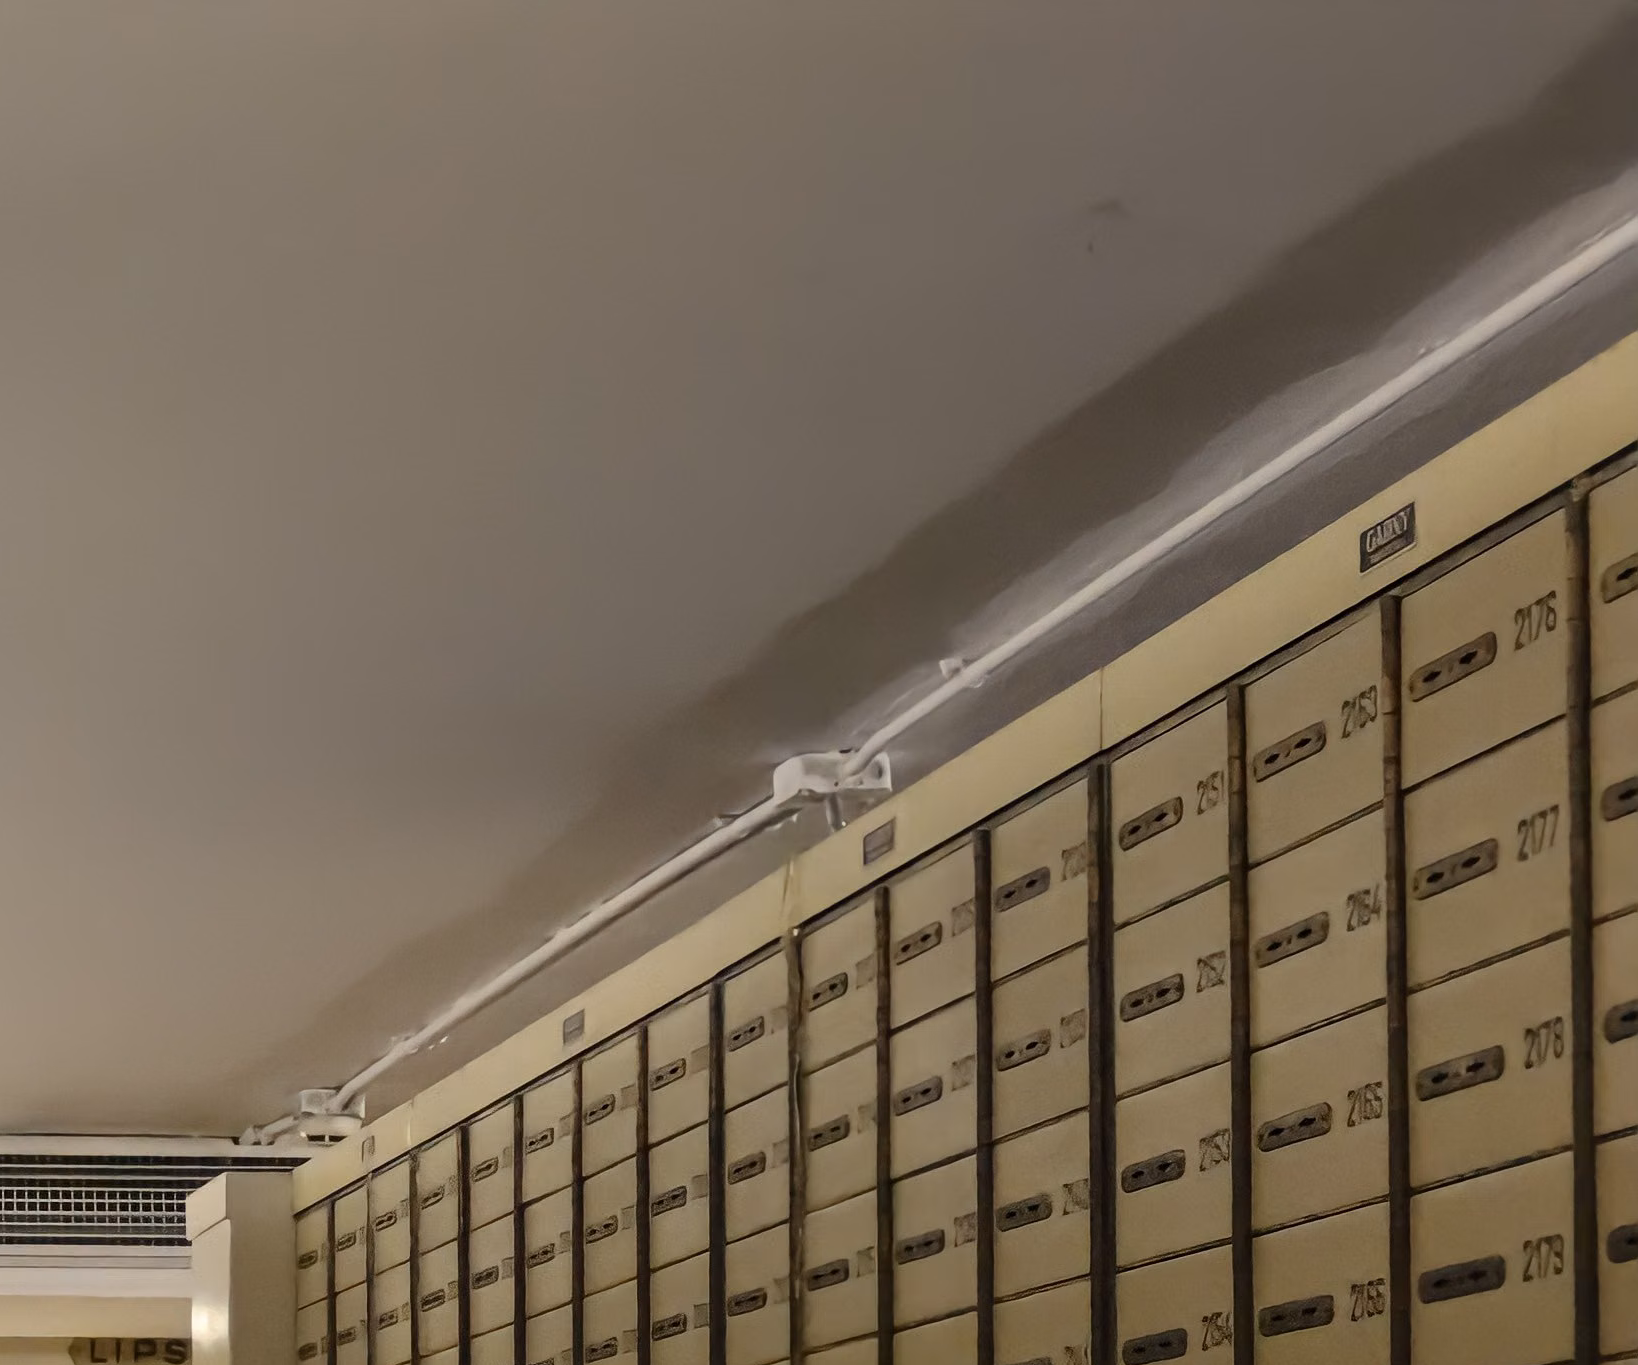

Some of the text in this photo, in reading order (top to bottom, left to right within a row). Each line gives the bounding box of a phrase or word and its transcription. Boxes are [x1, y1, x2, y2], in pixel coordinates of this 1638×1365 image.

[1513, 590, 1557, 651] 2176
[1517, 804, 1560, 863] 2177
[1523, 1016, 1564, 1069] 2178
[90, 1338, 188, 1365] LIPS
